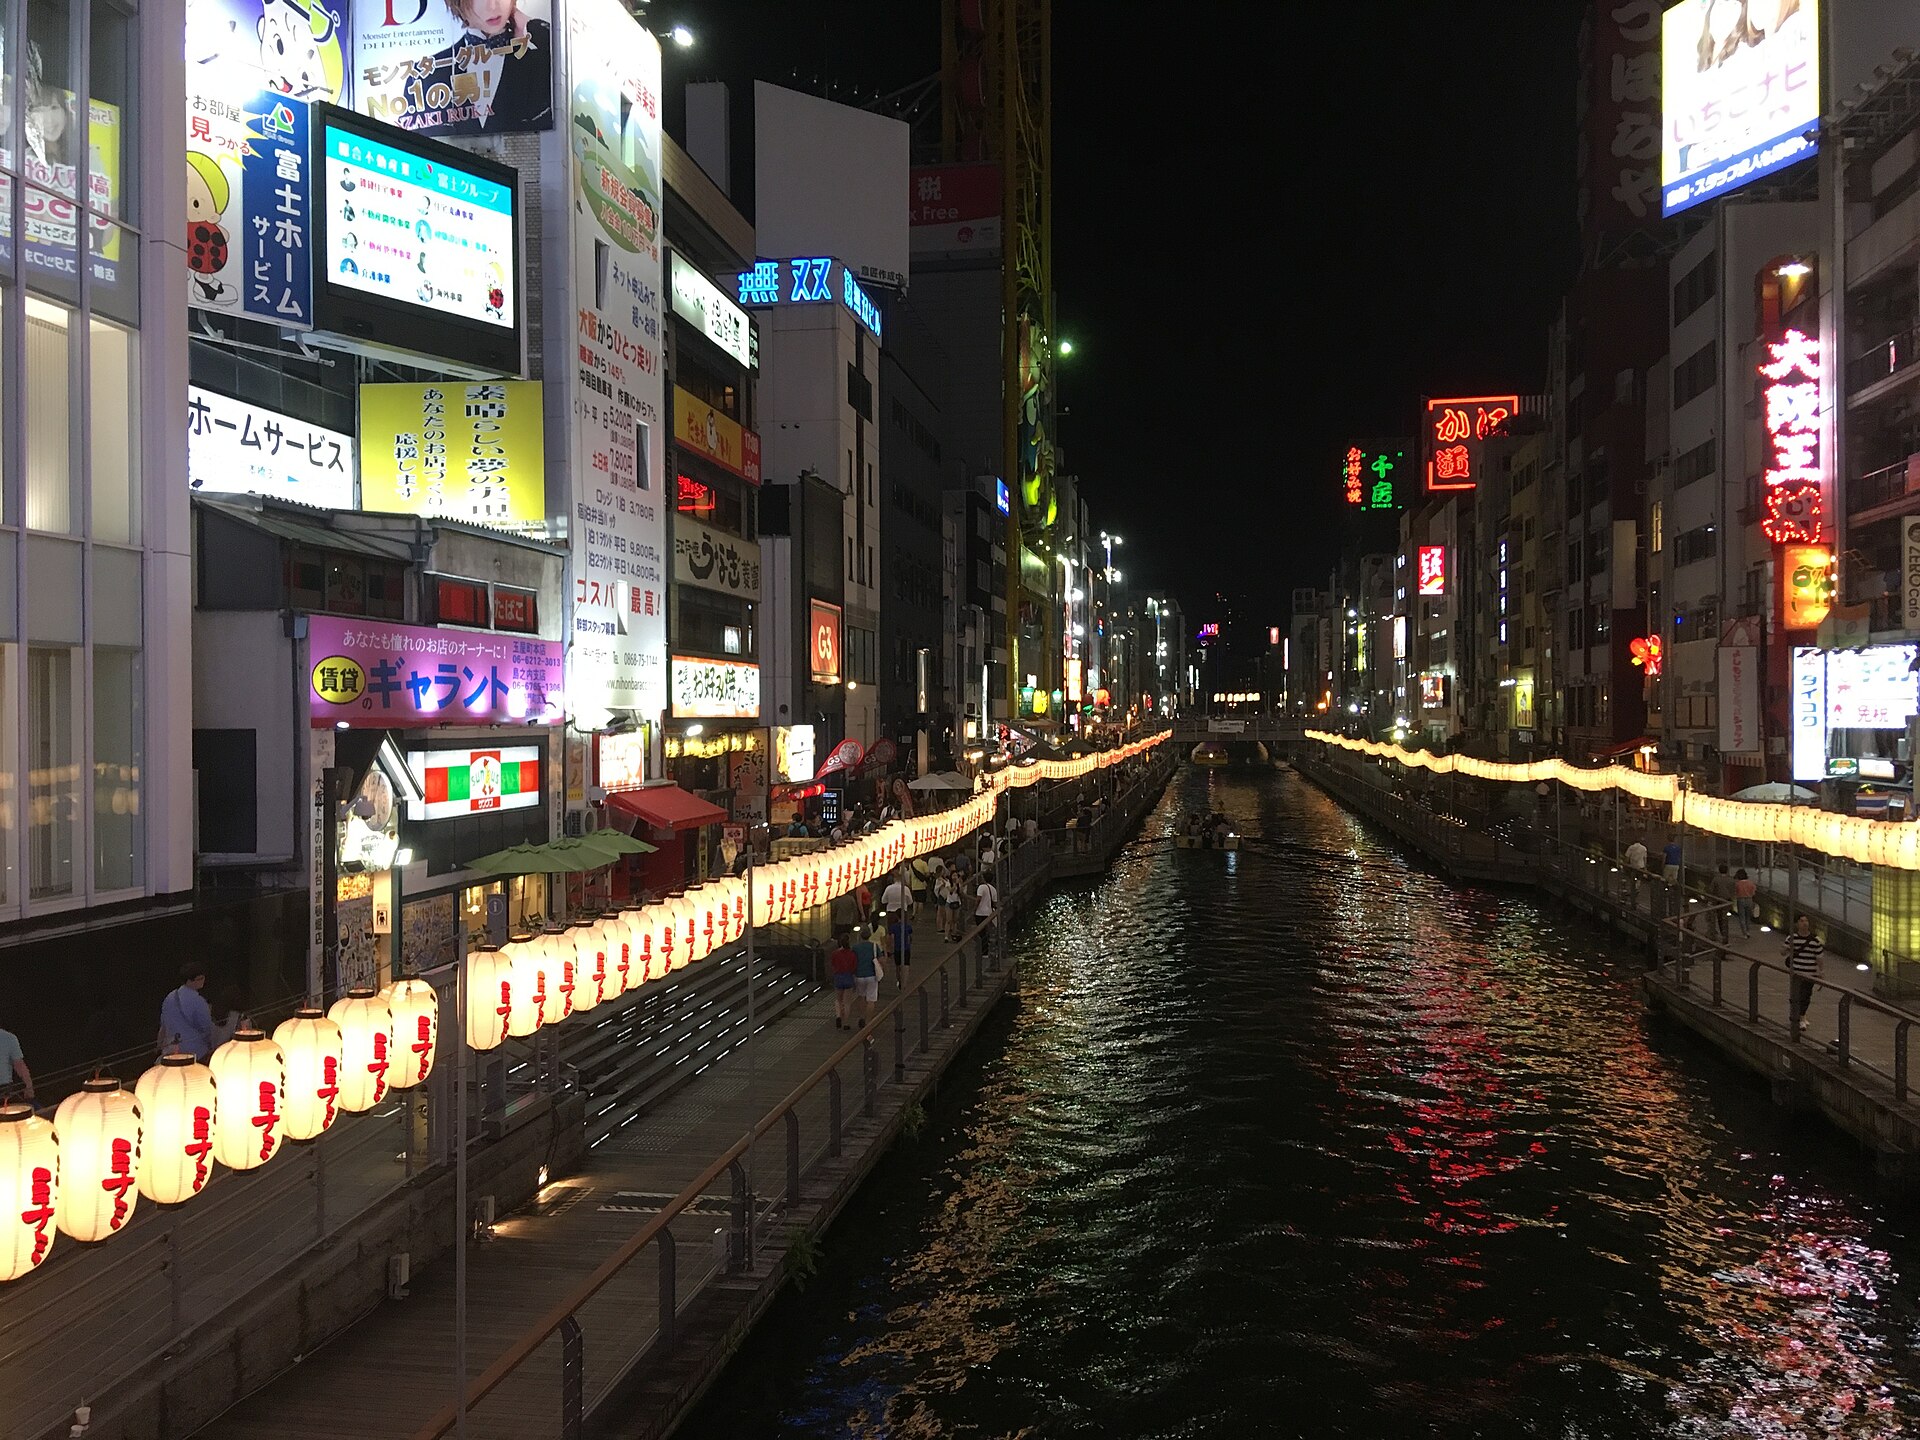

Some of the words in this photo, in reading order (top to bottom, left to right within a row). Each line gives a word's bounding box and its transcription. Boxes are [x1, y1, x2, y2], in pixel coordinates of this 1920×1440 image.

[363, 33, 534, 88] モンスターグループ
[190, 115, 251, 155] 見つかる
[192, 94, 241, 123] お部屋
[274, 148, 303, 318] 富士ホーム
[923, 206, 959, 220] Free
[252, 214, 273, 305] サービス
[738, 258, 832, 304] 無双
[188, 396, 344, 474] ホームサービス
[1371, 454, 1394, 503] 千房
[494, 599, 525, 623] たばこ
[577, 579, 615, 609] コスパ
[818, 624, 832, 662] G3
[320, 666, 359, 694] 賃貸
[367, 657, 510, 710] ギャラント
[827, 754, 841, 767] G3
[496, 981, 511, 1040] ミナミ
[532, 972, 546, 1028] ミナミ
[367, 1032, 390, 1102] ミナミ
[411, 1015, 433, 1081] ミナミ
[317, 1055, 340, 1130] ミナミ
[185, 1105, 213, 1192] ミナミ
[252, 1081, 281, 1161] ミナミ
[102, 1137, 135, 1231] ミナミ
[22, 1167, 55, 1265] ミナミ
